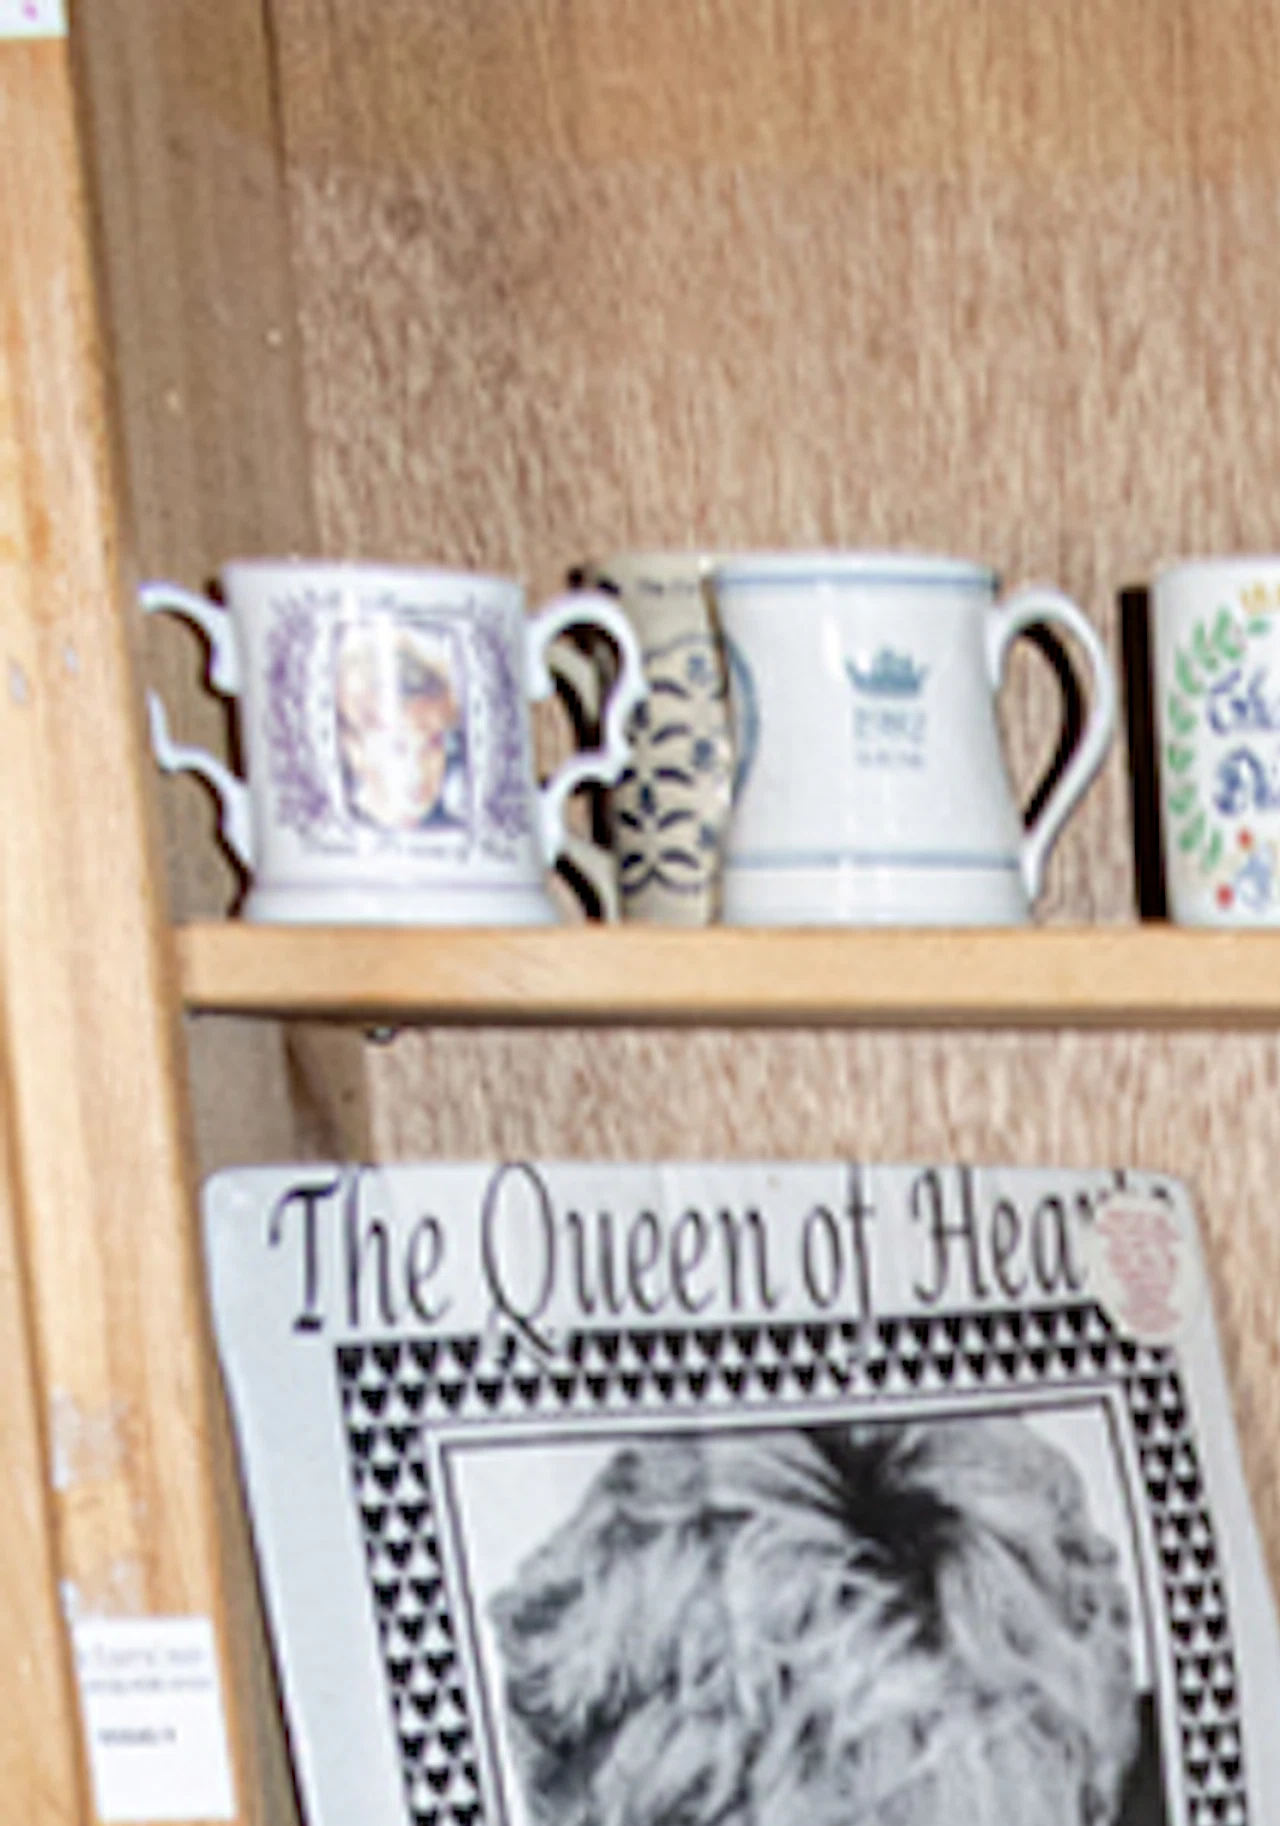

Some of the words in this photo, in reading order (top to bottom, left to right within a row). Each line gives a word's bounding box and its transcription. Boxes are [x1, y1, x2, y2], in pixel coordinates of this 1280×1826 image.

[270, 1167, 452, 1332] The
[481, 1161, 778, 1367] Queen
[801, 1163, 878, 1345] of
[914, 1162, 1172, 1304] Hea
